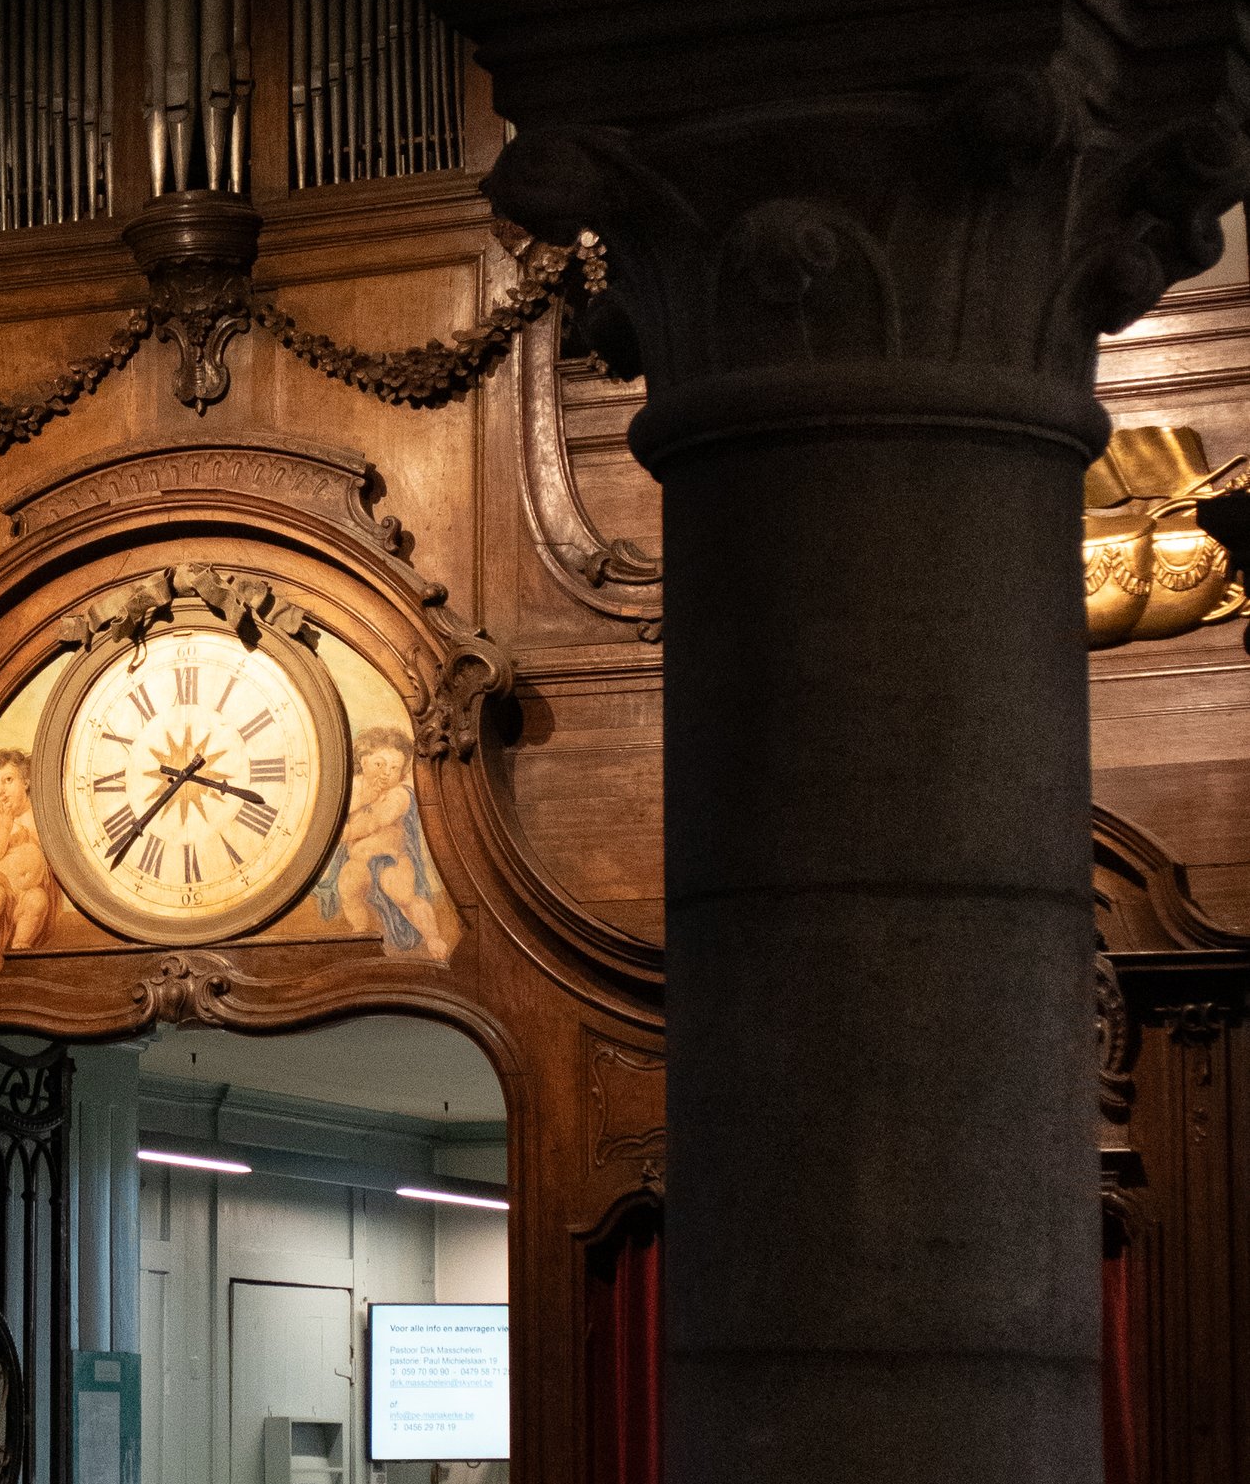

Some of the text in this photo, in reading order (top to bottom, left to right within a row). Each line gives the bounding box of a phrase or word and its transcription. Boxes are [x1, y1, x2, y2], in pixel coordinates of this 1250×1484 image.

[176, 644, 198, 658] 60
[172, 666, 200, 707] XII
[215, 676, 239, 714] I
[126, 682, 158, 728] XI
[101, 722, 135, 755] X
[237, 706, 276, 744] II
[93, 768, 127, 794] IX
[249, 757, 287, 783] III
[293, 760, 309, 779] 15
[102, 801, 141, 845] III
[136, 830, 167, 880] VII
[182, 843, 204, 885] VI
[220, 832, 246, 870] V
[181, 892, 205, 907] 30
[454, 1326, 496, 1334] aanvragen
[390, 1346, 483, 1354] Pastoor Dirk Masschelein
[423, 1357, 440, 1365] Paul
[489, 1356, 498, 1364] 19
[424, 1423, 434, 1431] 29
[447, 1423, 456, 1431] 19
